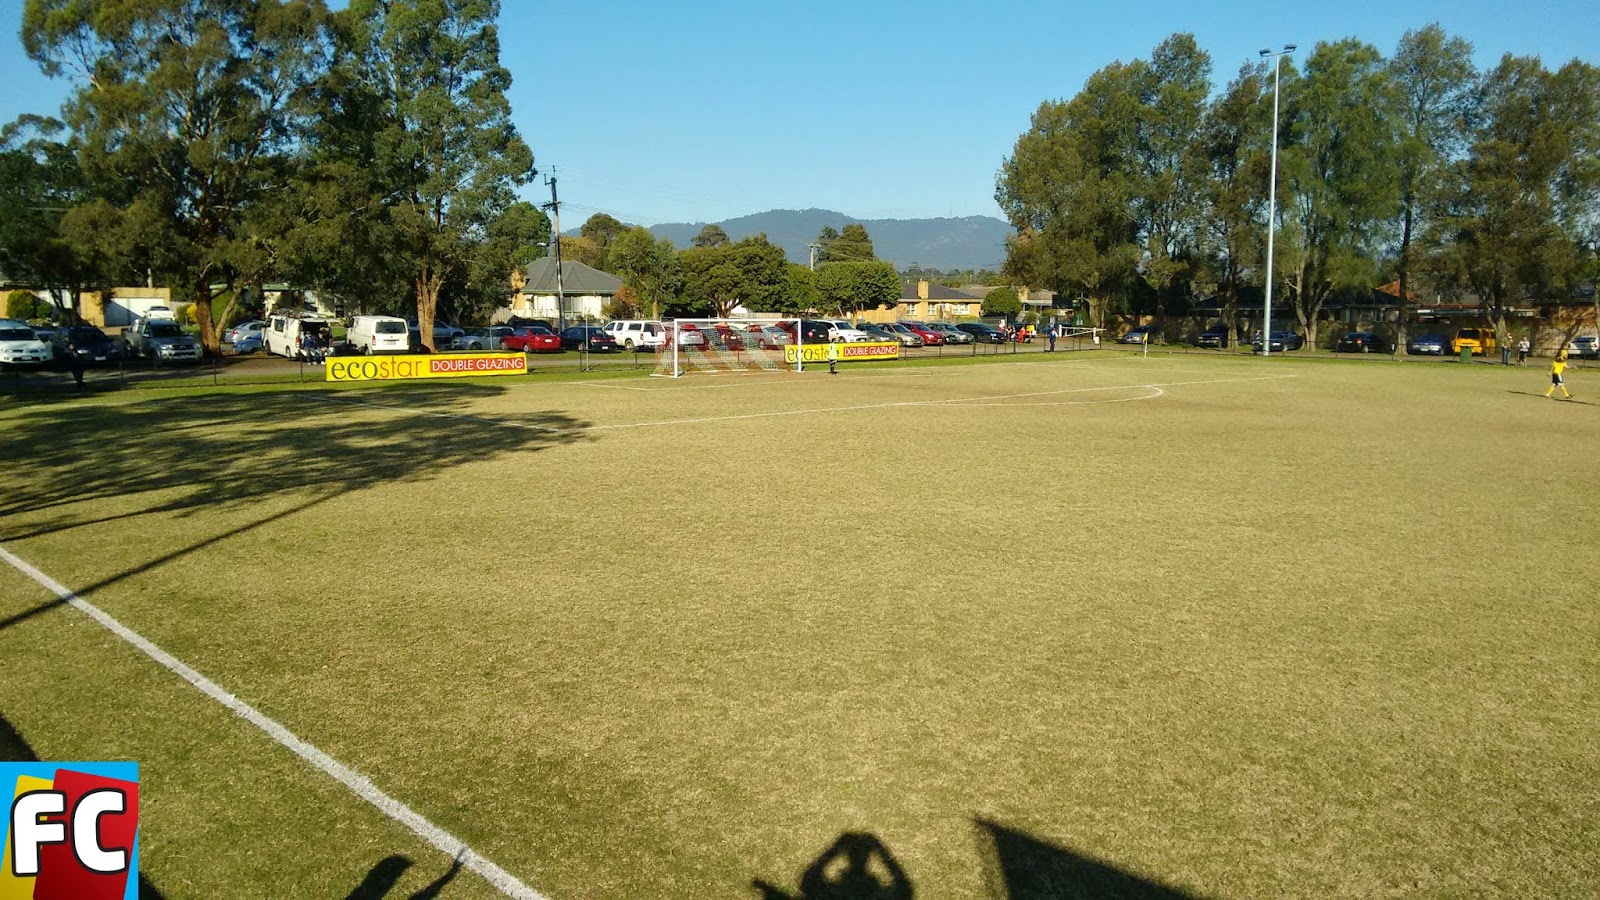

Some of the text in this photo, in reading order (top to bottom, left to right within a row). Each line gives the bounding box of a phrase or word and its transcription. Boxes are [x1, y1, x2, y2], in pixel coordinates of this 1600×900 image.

[788, 345, 896, 361] ecosta DOUBLE GLAZING
[331, 357, 523, 379] ecostar DOUBLE GLAZING
